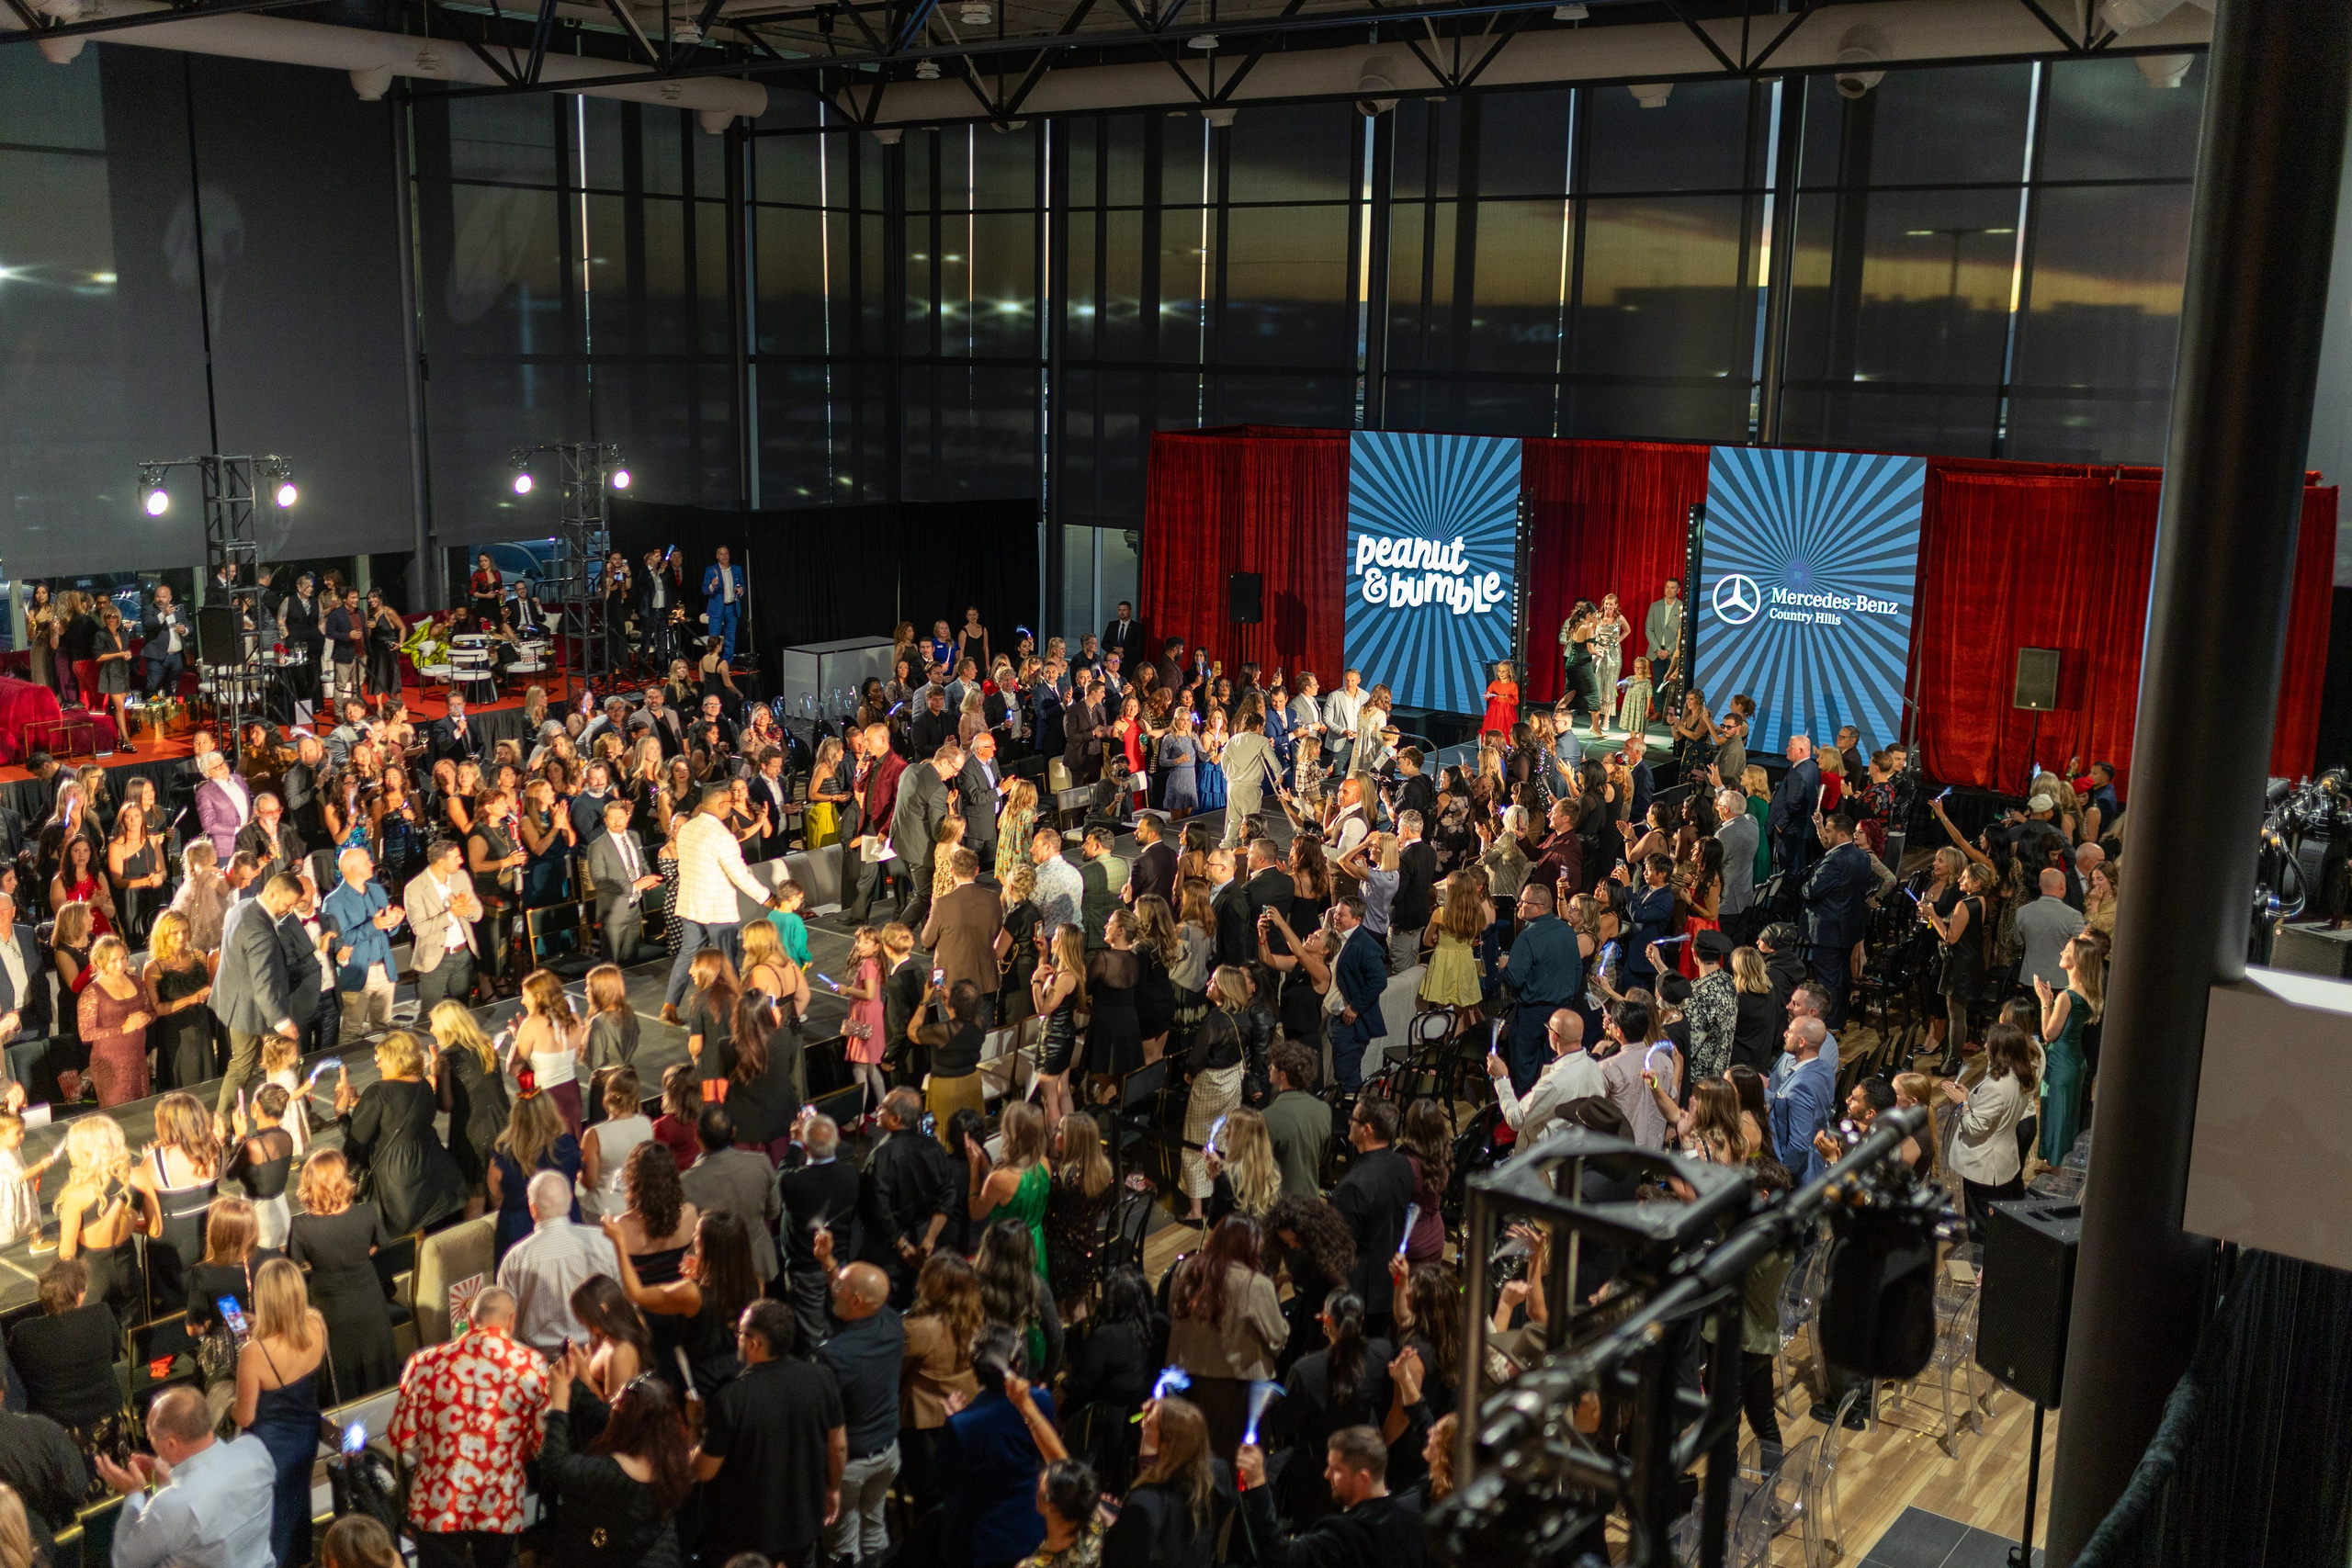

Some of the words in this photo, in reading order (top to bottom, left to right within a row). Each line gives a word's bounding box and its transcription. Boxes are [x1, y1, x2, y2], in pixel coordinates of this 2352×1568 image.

[1355, 534, 1470, 575] peanut
[1770, 587, 1899, 615] Mercedes-Benz
[1769, 607, 1814, 625] Country
[1815, 611, 1842, 626] Hills
